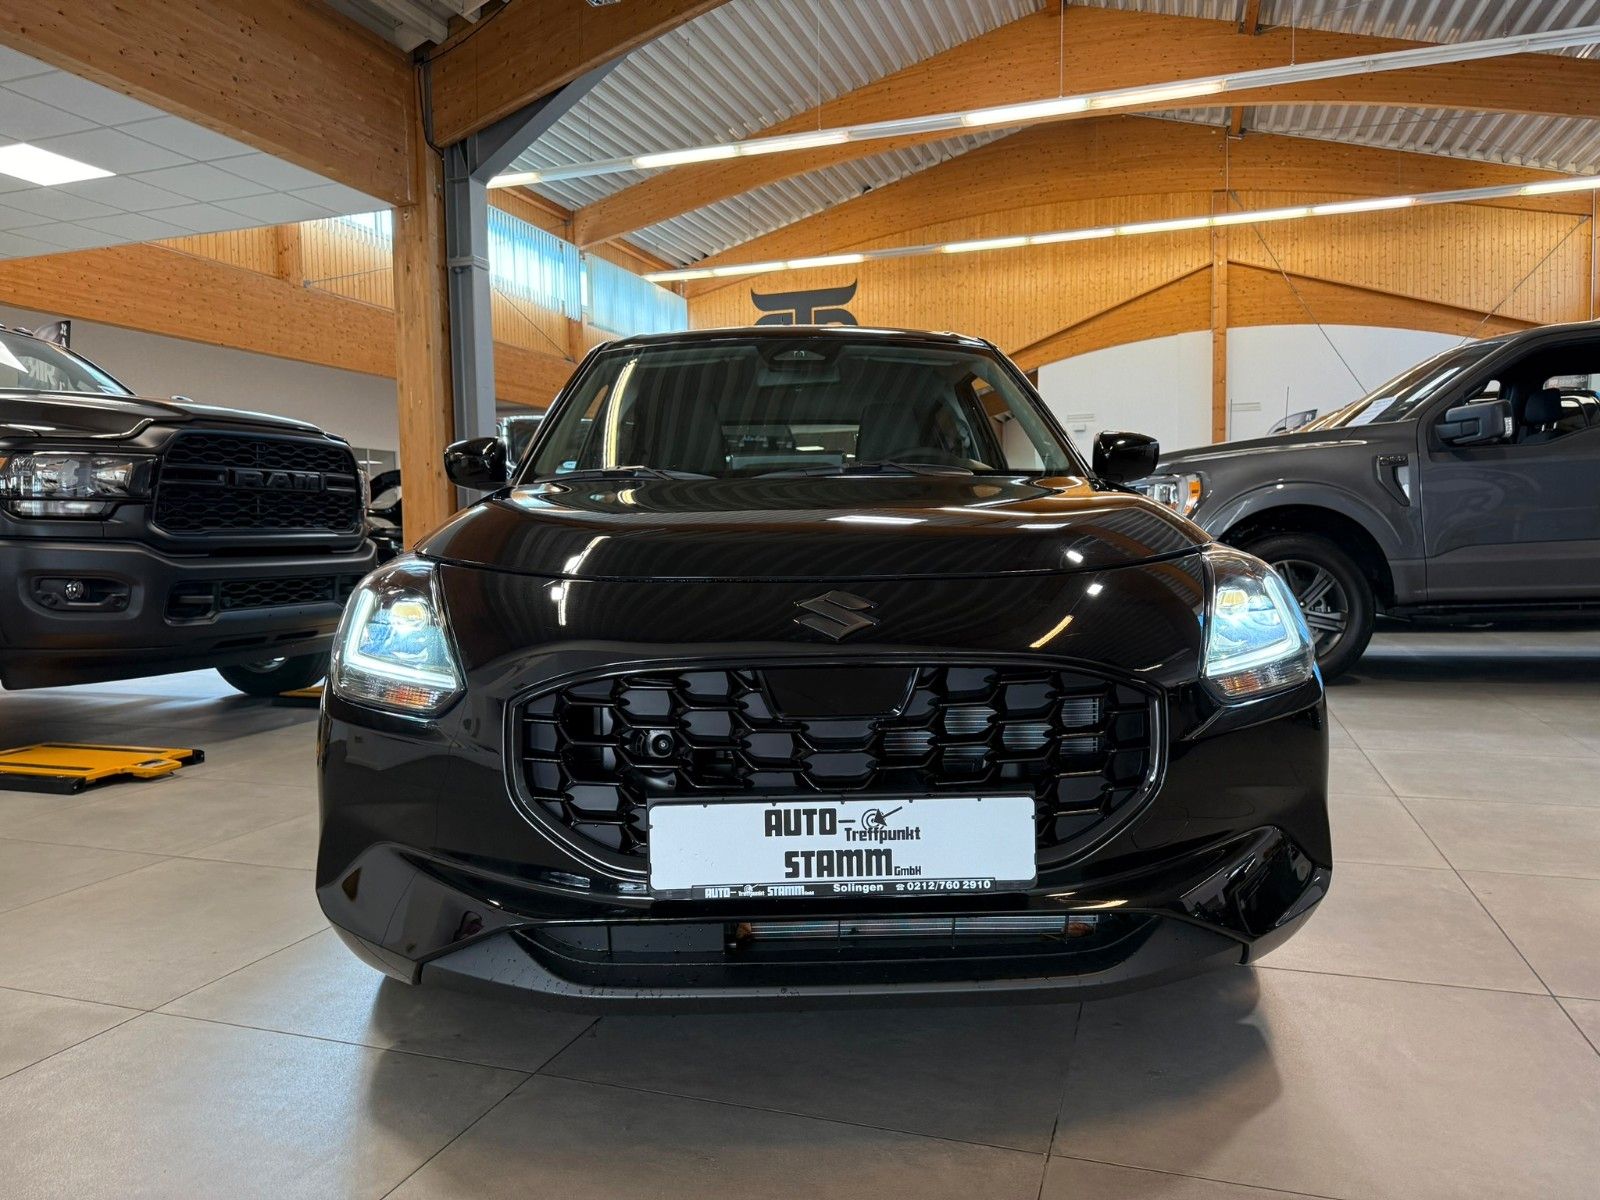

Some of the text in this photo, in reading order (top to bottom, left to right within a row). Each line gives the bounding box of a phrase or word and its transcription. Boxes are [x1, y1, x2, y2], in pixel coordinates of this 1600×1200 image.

[234, 469, 320, 489] RAM
[844, 826, 921, 844] Treffpunkt
[784, 848, 922, 879] STAMM GmbH
[767, 885, 805, 897] STAMM
[833, 883, 884, 893] Solingen
[906, 880, 959, 891] 0212/760
[962, 880, 991, 890] 2910
